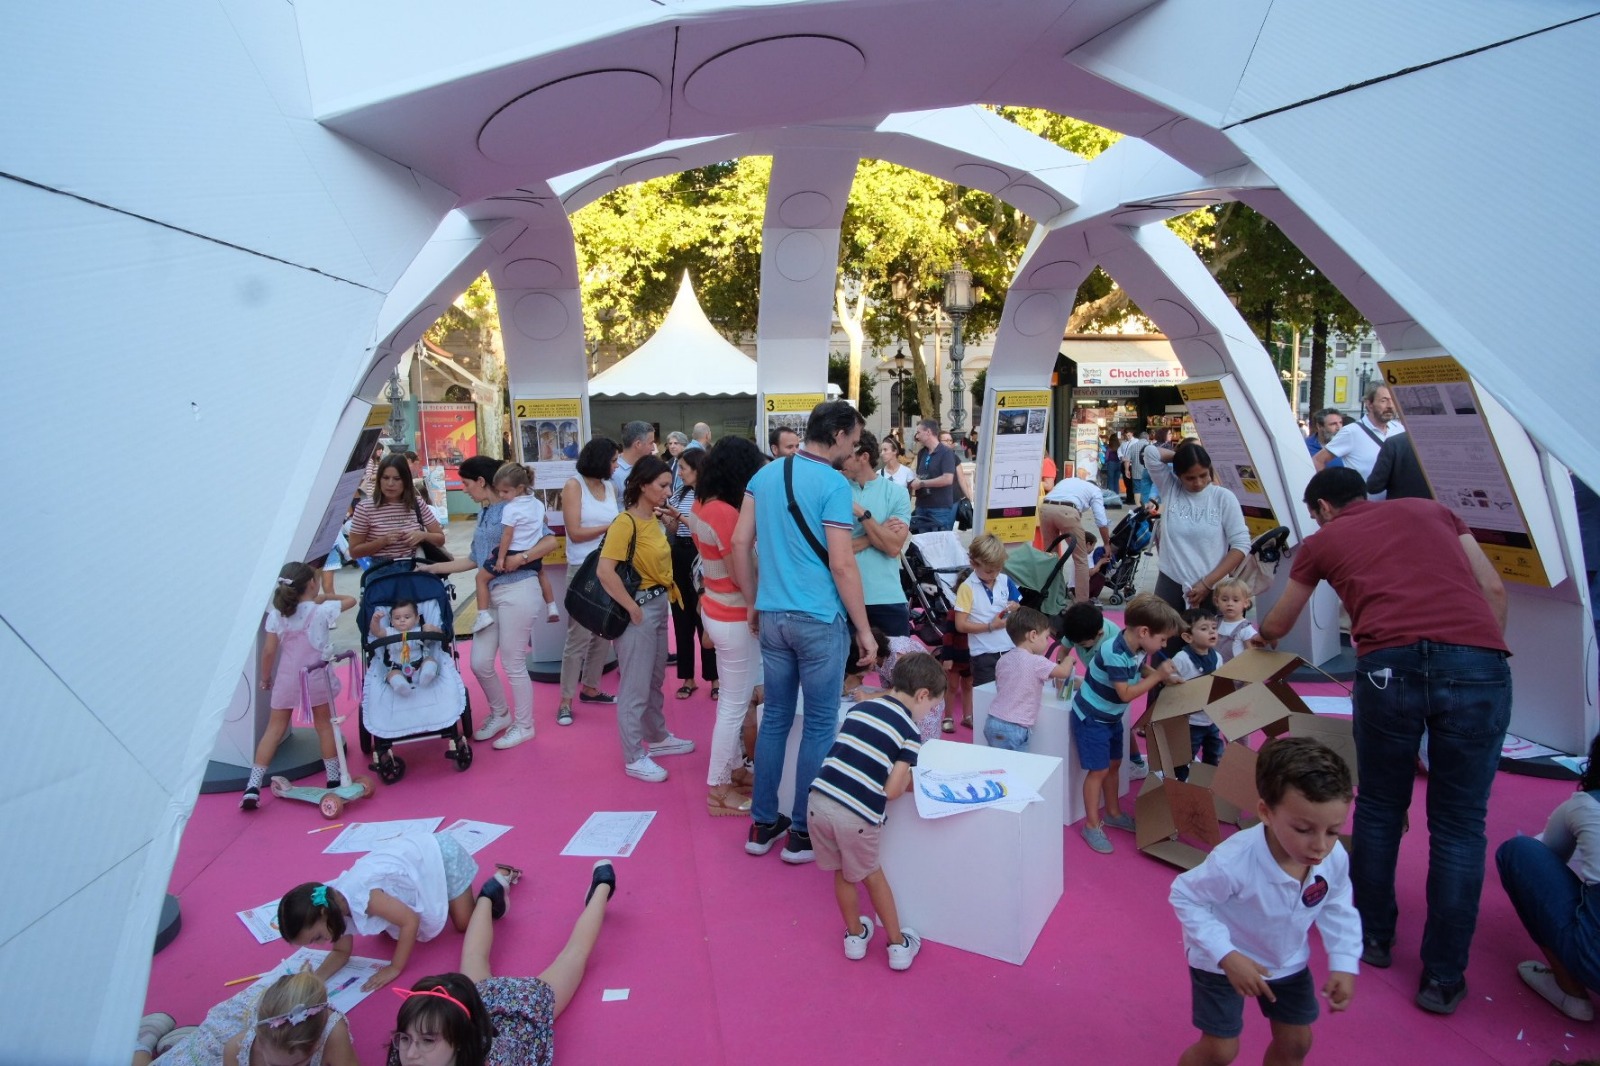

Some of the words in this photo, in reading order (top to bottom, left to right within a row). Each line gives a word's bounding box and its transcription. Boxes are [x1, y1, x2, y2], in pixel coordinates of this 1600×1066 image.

[1109, 368, 1170, 378] Chucherías
[1387, 369, 1397, 384] 6
[1101, 388, 1118, 396] COLD
[1181, 389, 1189, 401] 5
[766, 399, 775, 411] 3
[997, 396, 1006, 407] 4
[517, 405, 527, 417] 2
